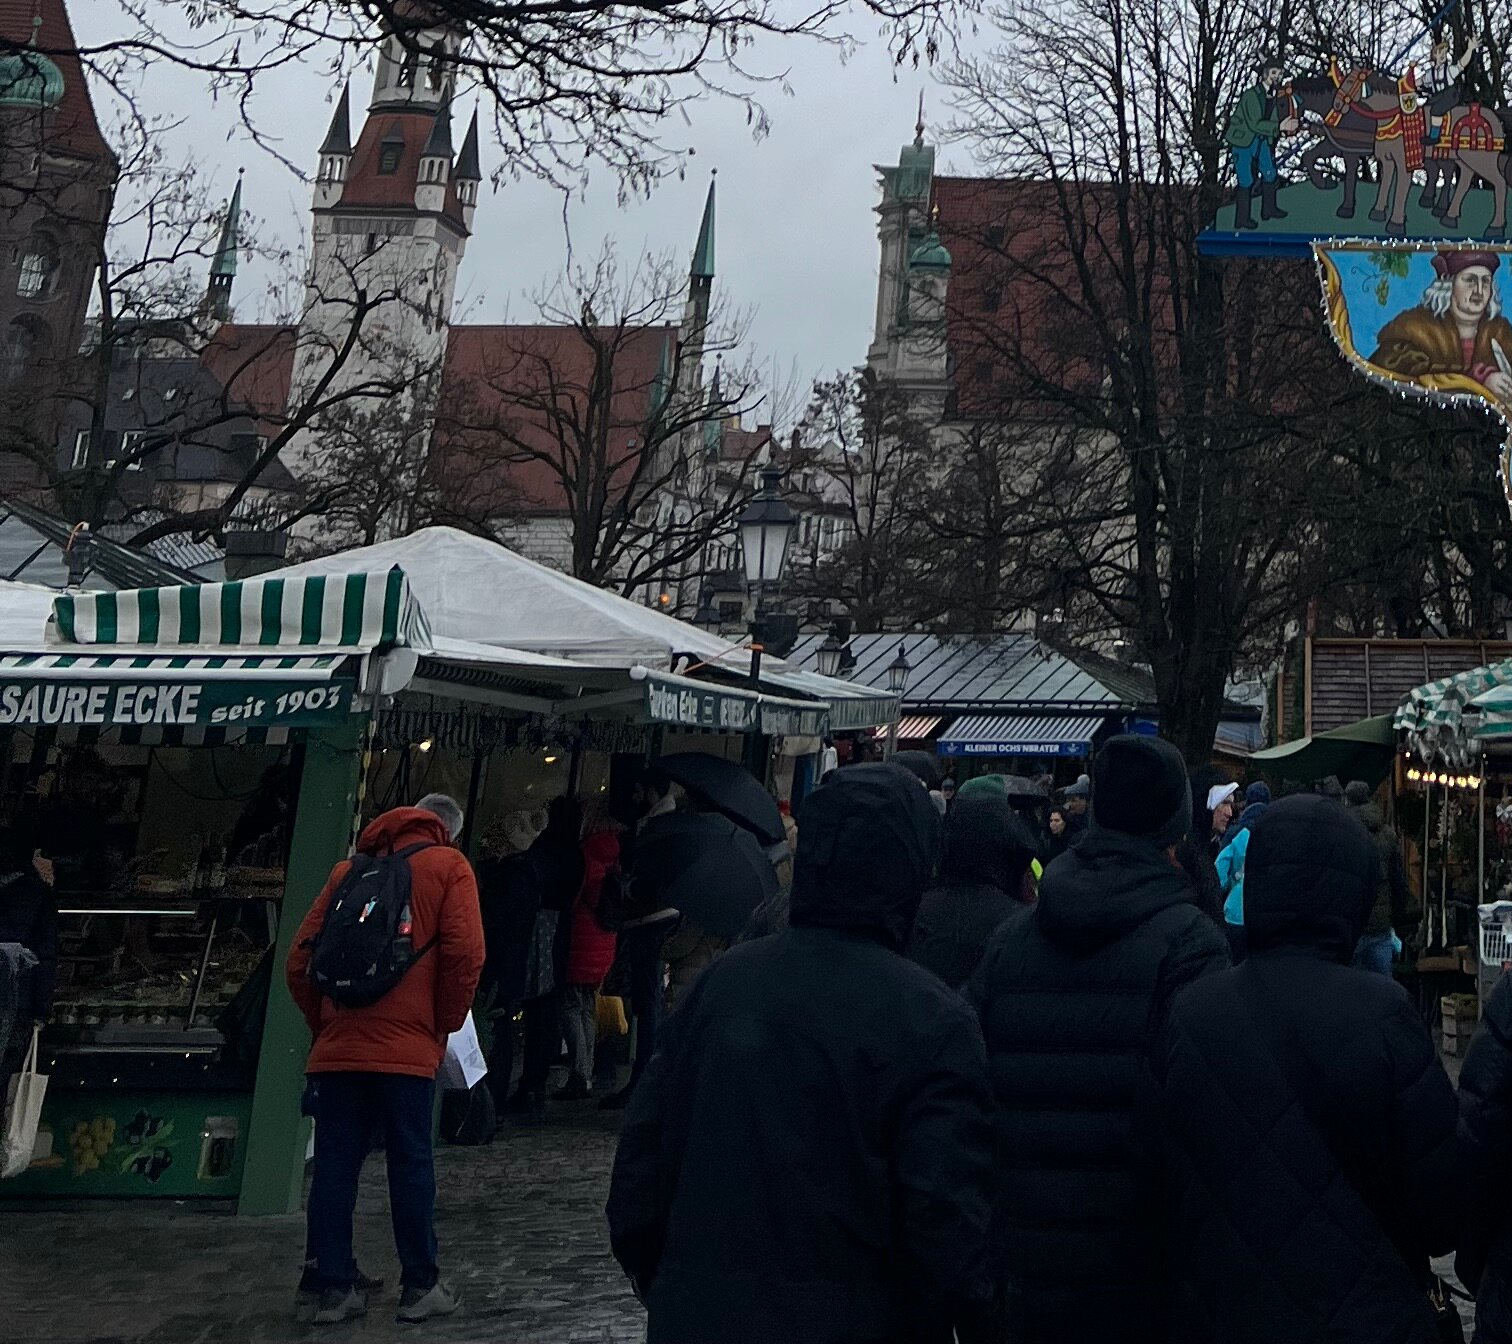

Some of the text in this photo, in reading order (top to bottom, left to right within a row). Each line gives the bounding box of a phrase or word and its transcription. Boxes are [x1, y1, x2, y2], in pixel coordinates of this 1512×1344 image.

[1, 685, 343, 724] SAURE ECKE seit 1903
[964, 744, 997, 752] KLEINER
